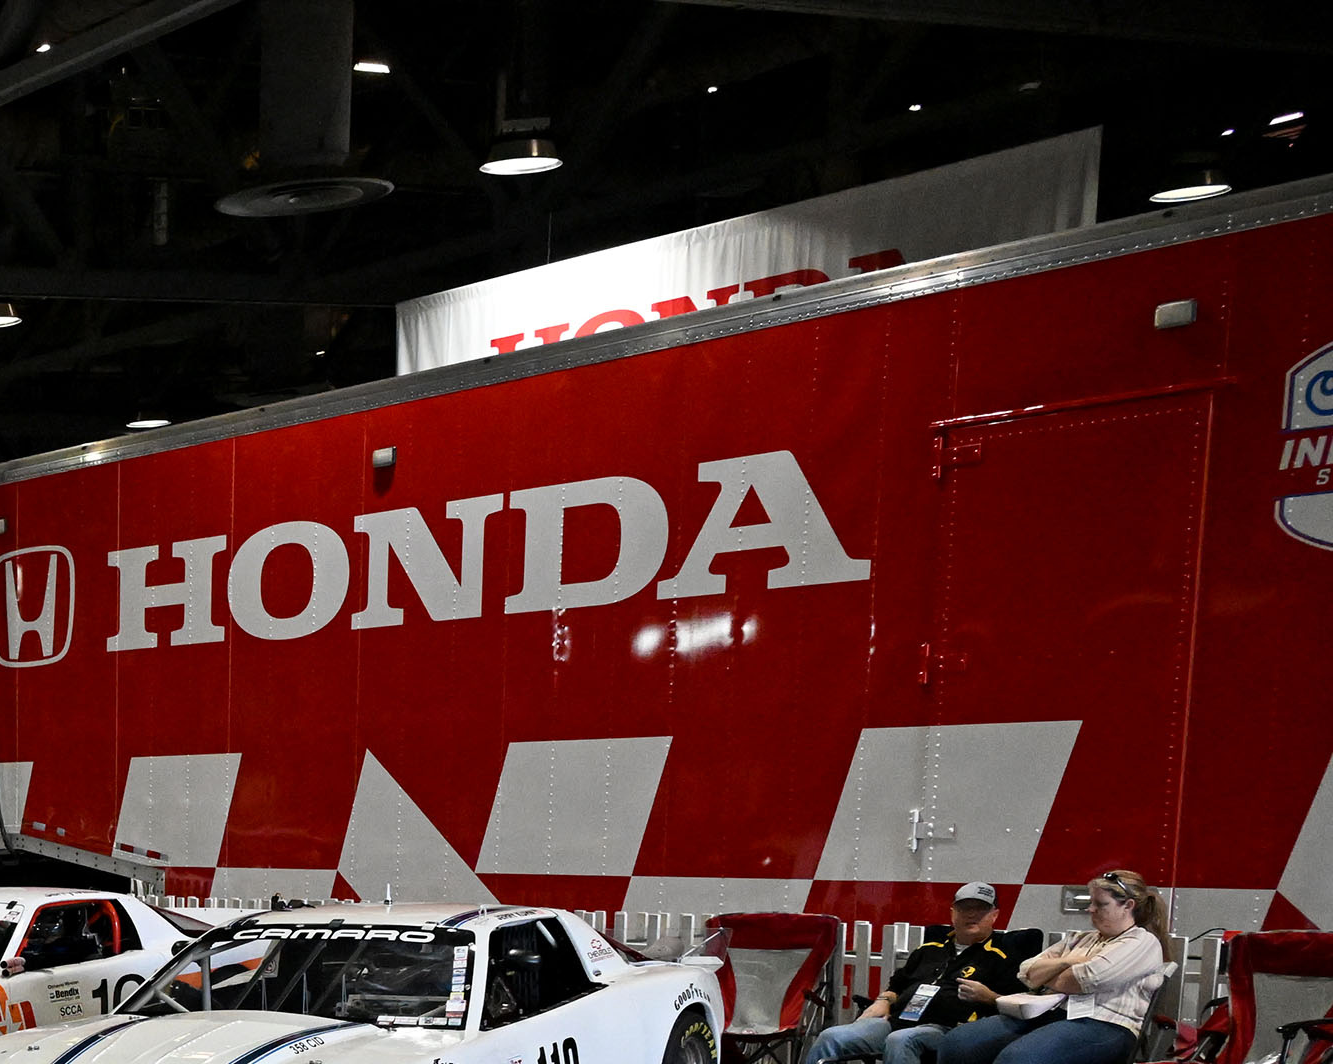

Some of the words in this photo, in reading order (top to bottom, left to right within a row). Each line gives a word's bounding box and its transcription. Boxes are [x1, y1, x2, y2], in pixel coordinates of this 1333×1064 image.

[105, 450, 871, 652] HONDA
[233, 928, 436, 943] CAMARO
[55, 985, 81, 999] Bendix
[60, 1005, 83, 1018] SCCA
[289, 1041, 309, 1054] 358
[306, 1036, 325, 1048] CID
